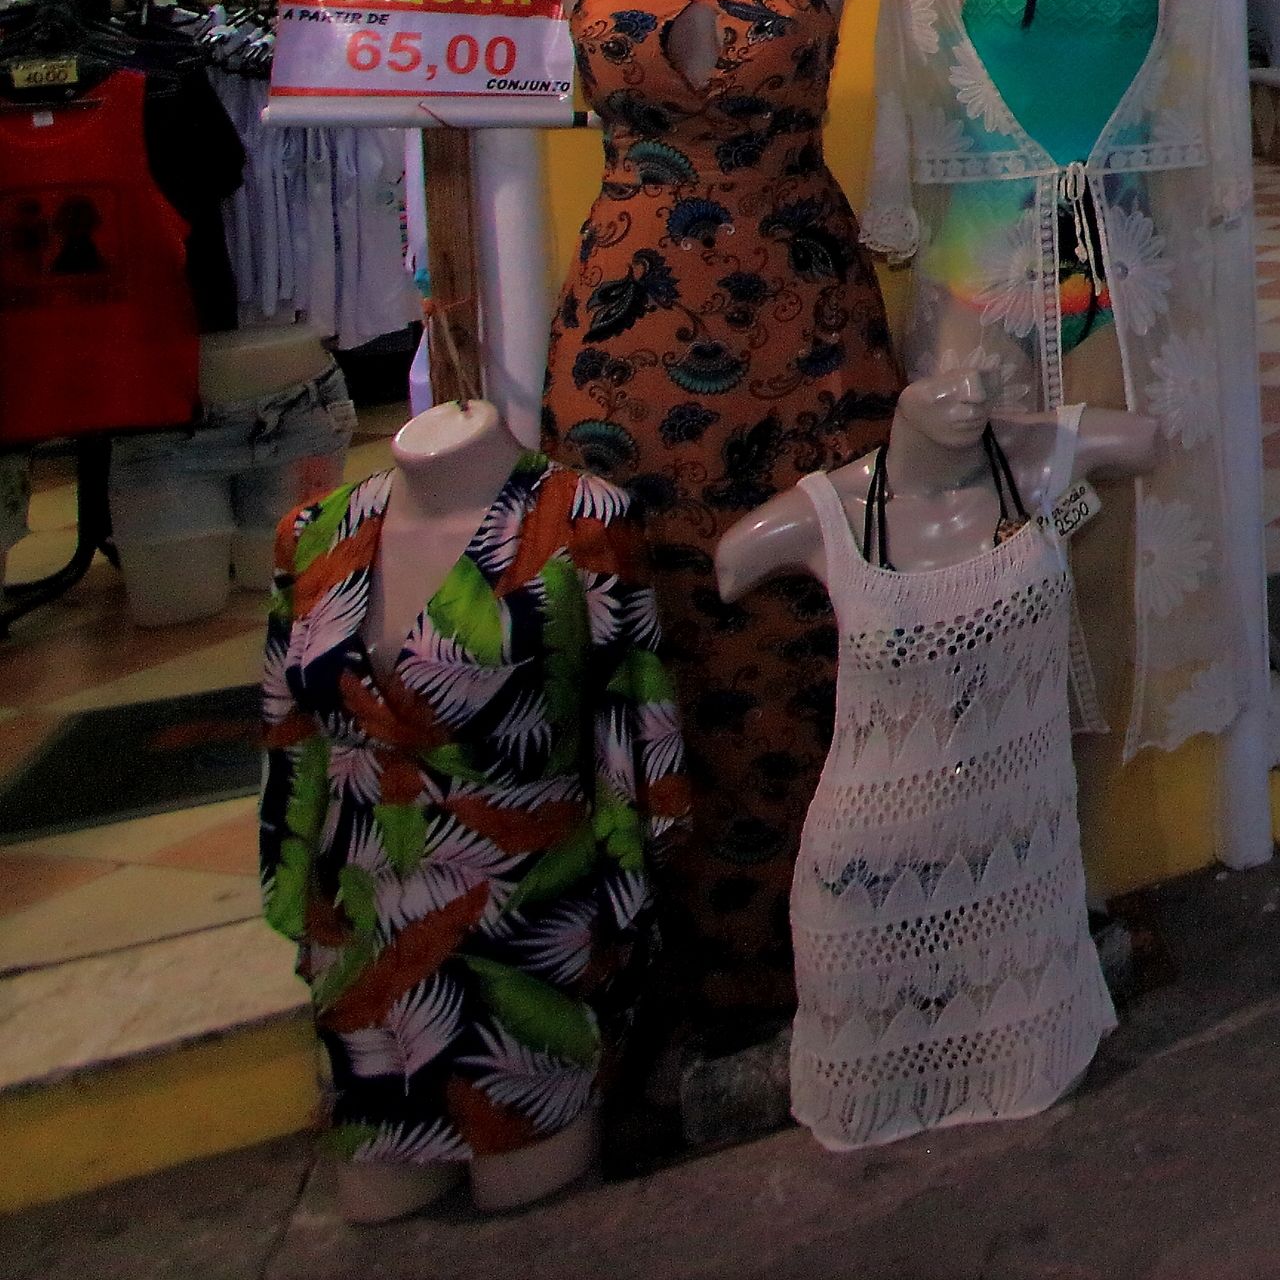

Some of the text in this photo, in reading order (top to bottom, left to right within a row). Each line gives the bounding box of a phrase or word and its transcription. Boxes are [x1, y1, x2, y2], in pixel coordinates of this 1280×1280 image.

[283, 9, 294, 21] A
[366, 12, 391, 26] DE
[346, 30, 518, 81] 65,00
[486, 78, 571, 94] CONJUNTO
